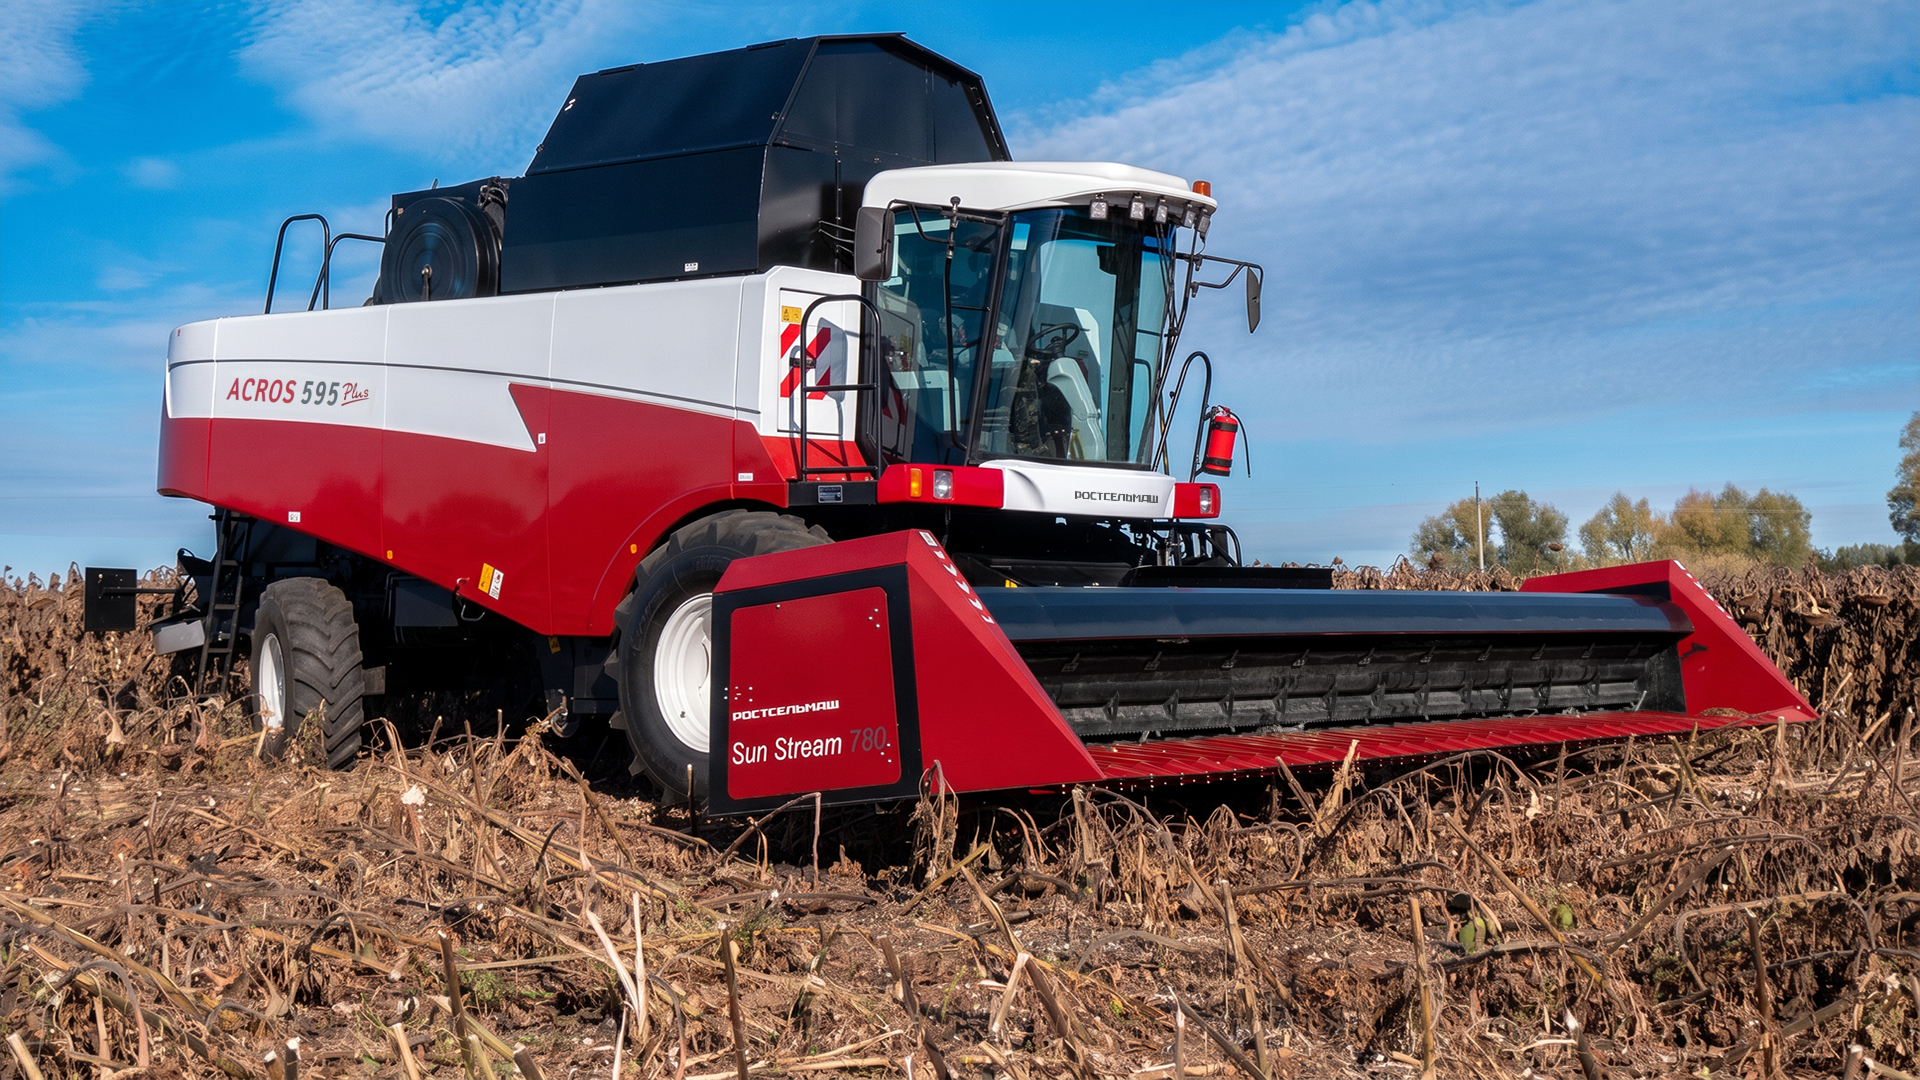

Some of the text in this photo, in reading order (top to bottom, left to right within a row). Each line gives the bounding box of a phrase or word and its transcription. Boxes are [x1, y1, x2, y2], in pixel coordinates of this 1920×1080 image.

[226, 378, 370, 406] ACROS 595 Plus
[1074, 490, 1159, 504] РОСТСЕЛЬМАШ
[732, 699, 840, 721] РОСТСЕЛЬМАШ
[732, 726, 887, 765] Sun Stream 780
